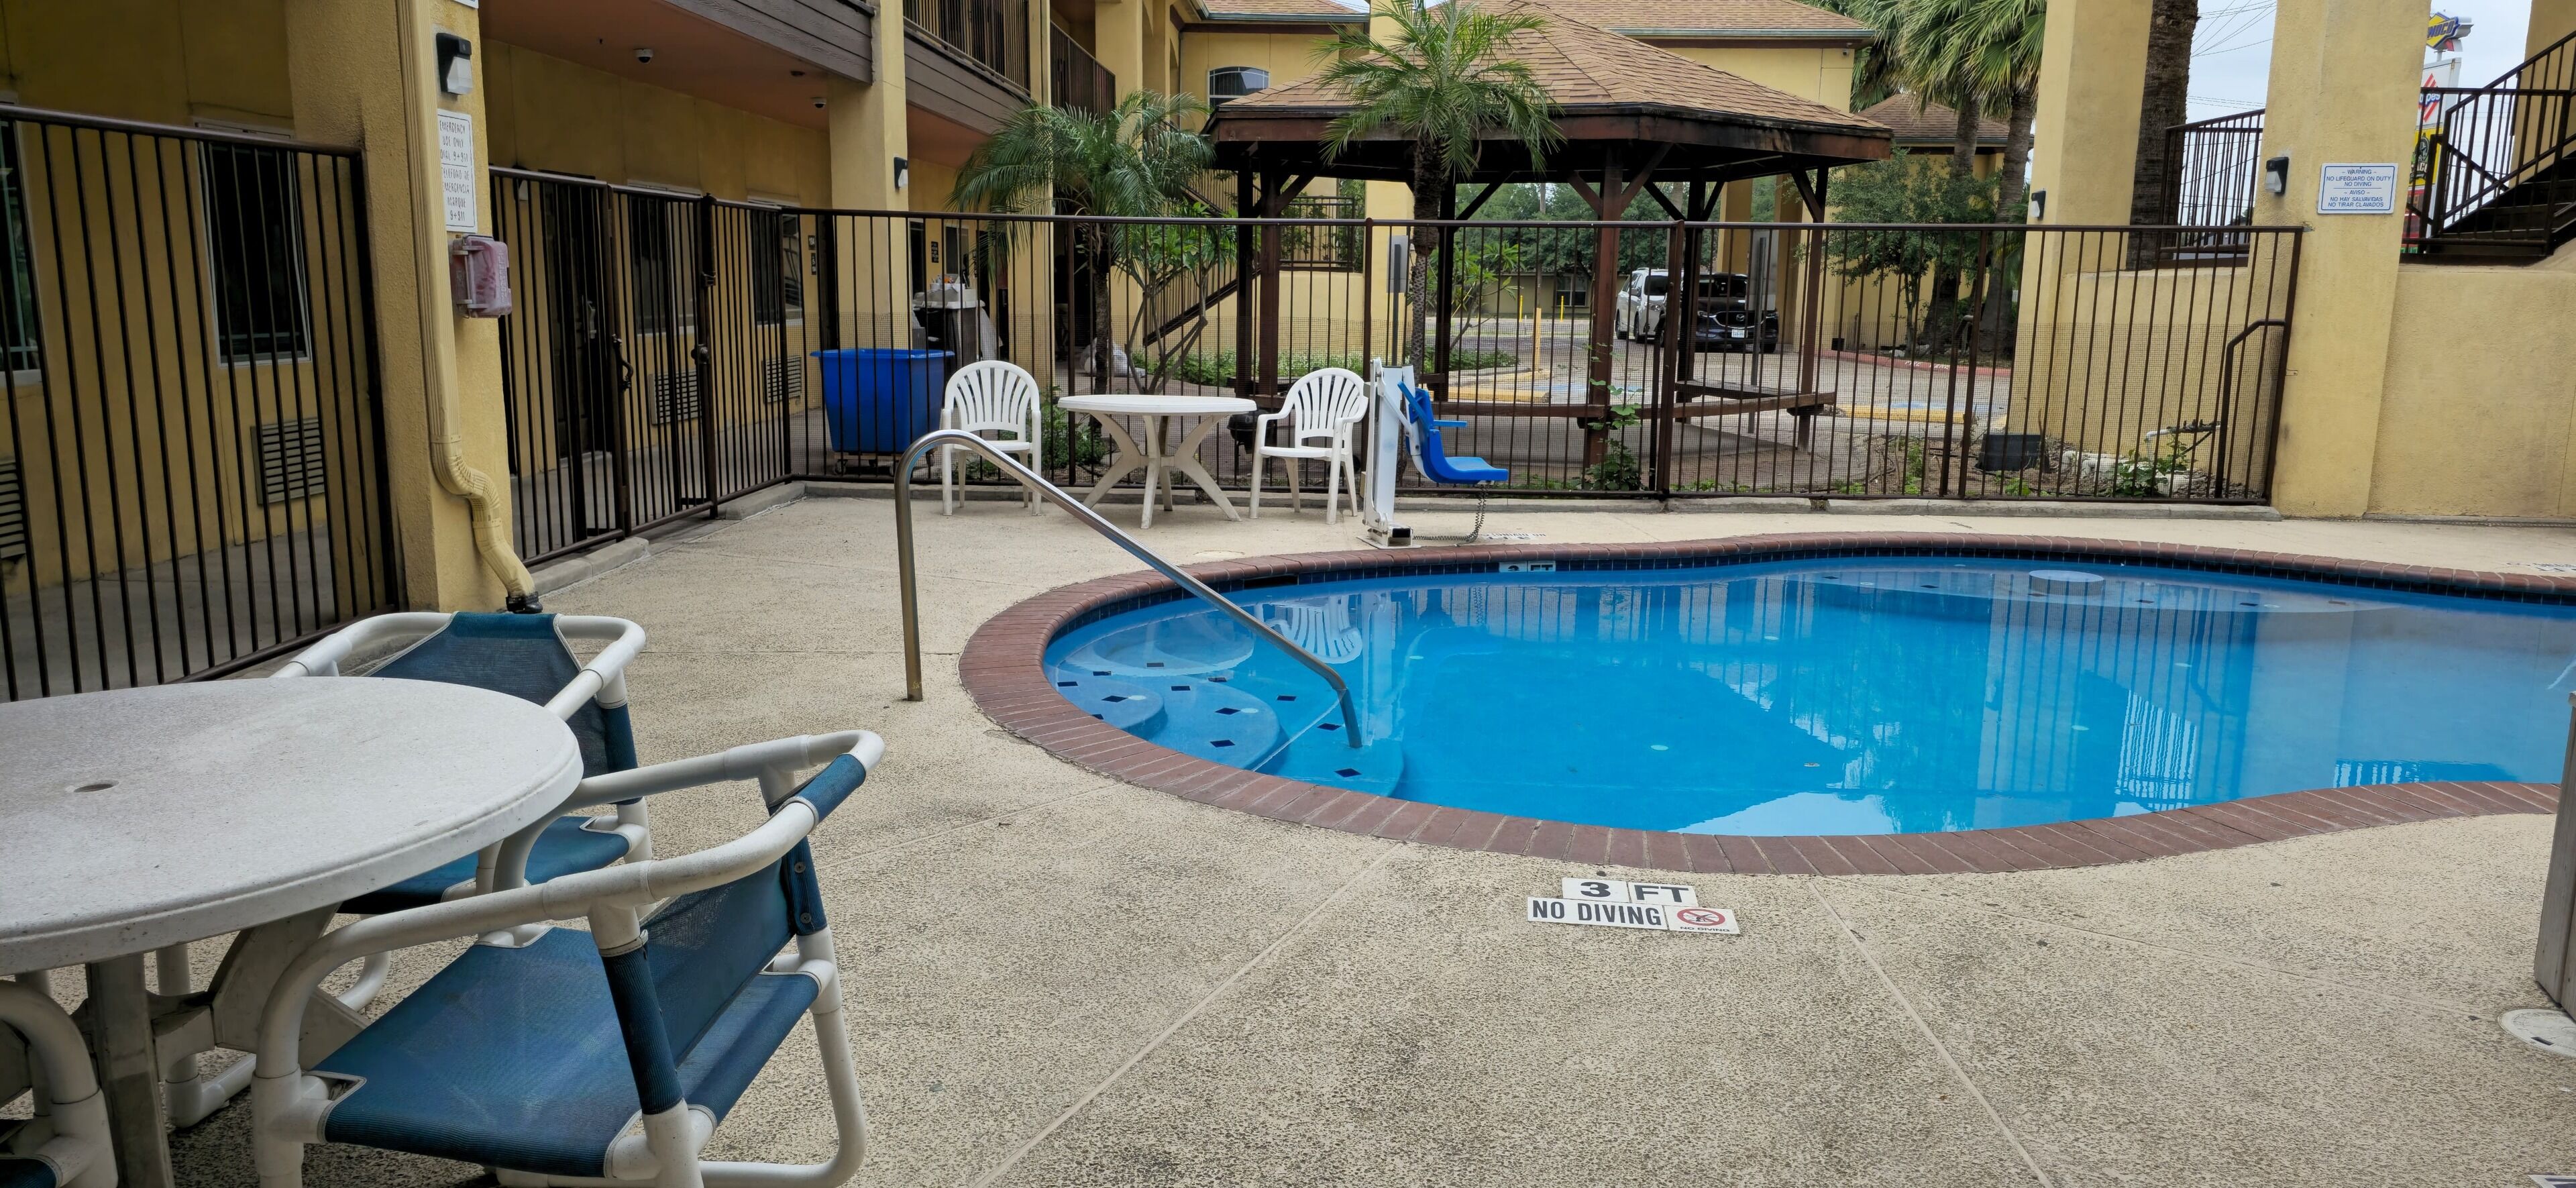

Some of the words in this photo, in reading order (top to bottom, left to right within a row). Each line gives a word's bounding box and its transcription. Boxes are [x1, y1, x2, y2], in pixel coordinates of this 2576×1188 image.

[2426, 20, 2455, 38] NOCO
[439, 120, 466, 134] EMERGENCY
[443, 136, 451, 146] USE
[453, 137, 464, 148] ONLY
[440, 149, 451, 161] DIAL
[441, 167, 462, 180] ELEFONO
[443, 182, 470, 194] MERGENCIA
[447, 197, 466, 209] MARQUE
[449, 210, 466, 221] 9+911
[1580, 881, 1611, 898] 3
[1634, 884, 1689, 903] FT
[1532, 900, 1565, 920] NO
[1577, 902, 1662, 926] DIVING
